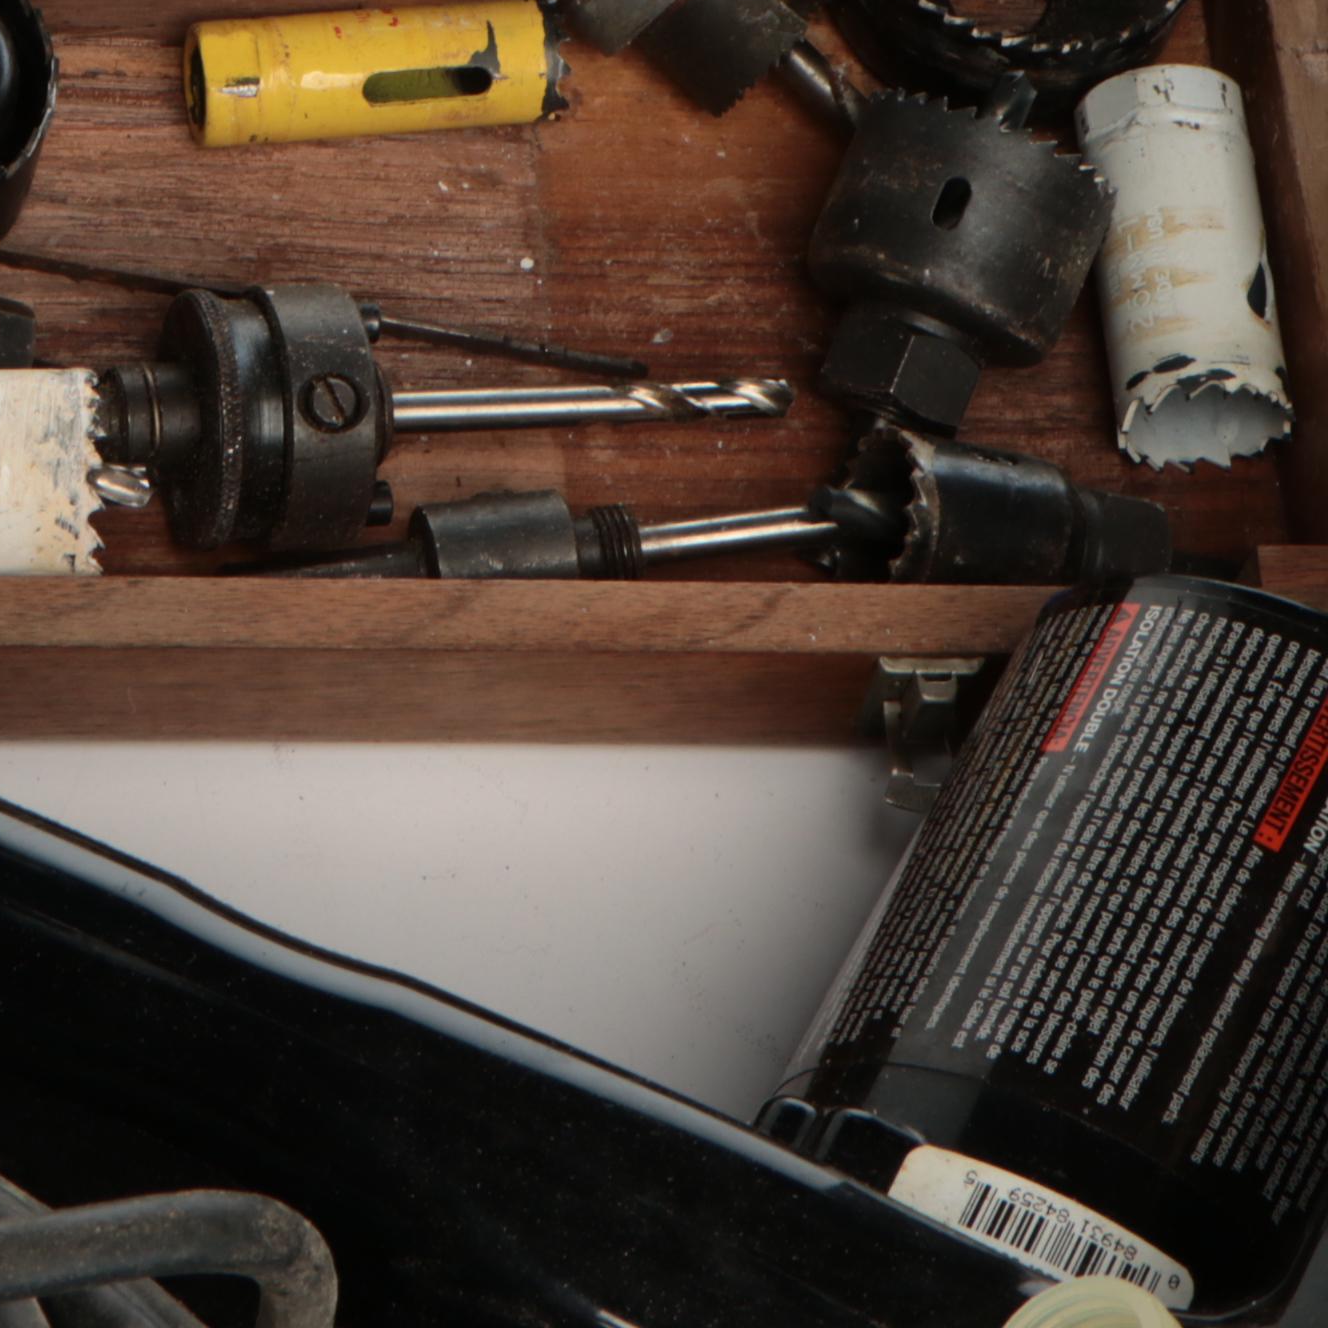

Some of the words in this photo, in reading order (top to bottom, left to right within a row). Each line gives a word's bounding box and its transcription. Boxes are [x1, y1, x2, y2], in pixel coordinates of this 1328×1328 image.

[1108, 602, 1162, 688] ISOLATION
[1073, 684, 1118, 754] DOUBLE
[1234, 867, 1251, 885] de
[1242, 844, 1264, 870] Afin
[1281, 860, 1306, 893] When
[1214, 882, 1244, 923] réduire
[1254, 890, 1288, 940] servicing
[1205, 920, 1224, 941] les
[1245, 937, 1264, 961] use
[1182, 937, 1213, 980] risques
[1231, 957, 1255, 984] only
[1176, 977, 1194, 996] de
[1210, 982, 1243, 1030] identical
[1116, 1048, 1158, 1110] l'utilisateur
[1175, 1027, 1219, 1095] replacement
[961, 1167, 979, 1187] 5
[1006, 1181, 1072, 1227] 84259
[1076, 1217, 1140, 1263] 84931
[1165, 1272, 1183, 1291] 0
